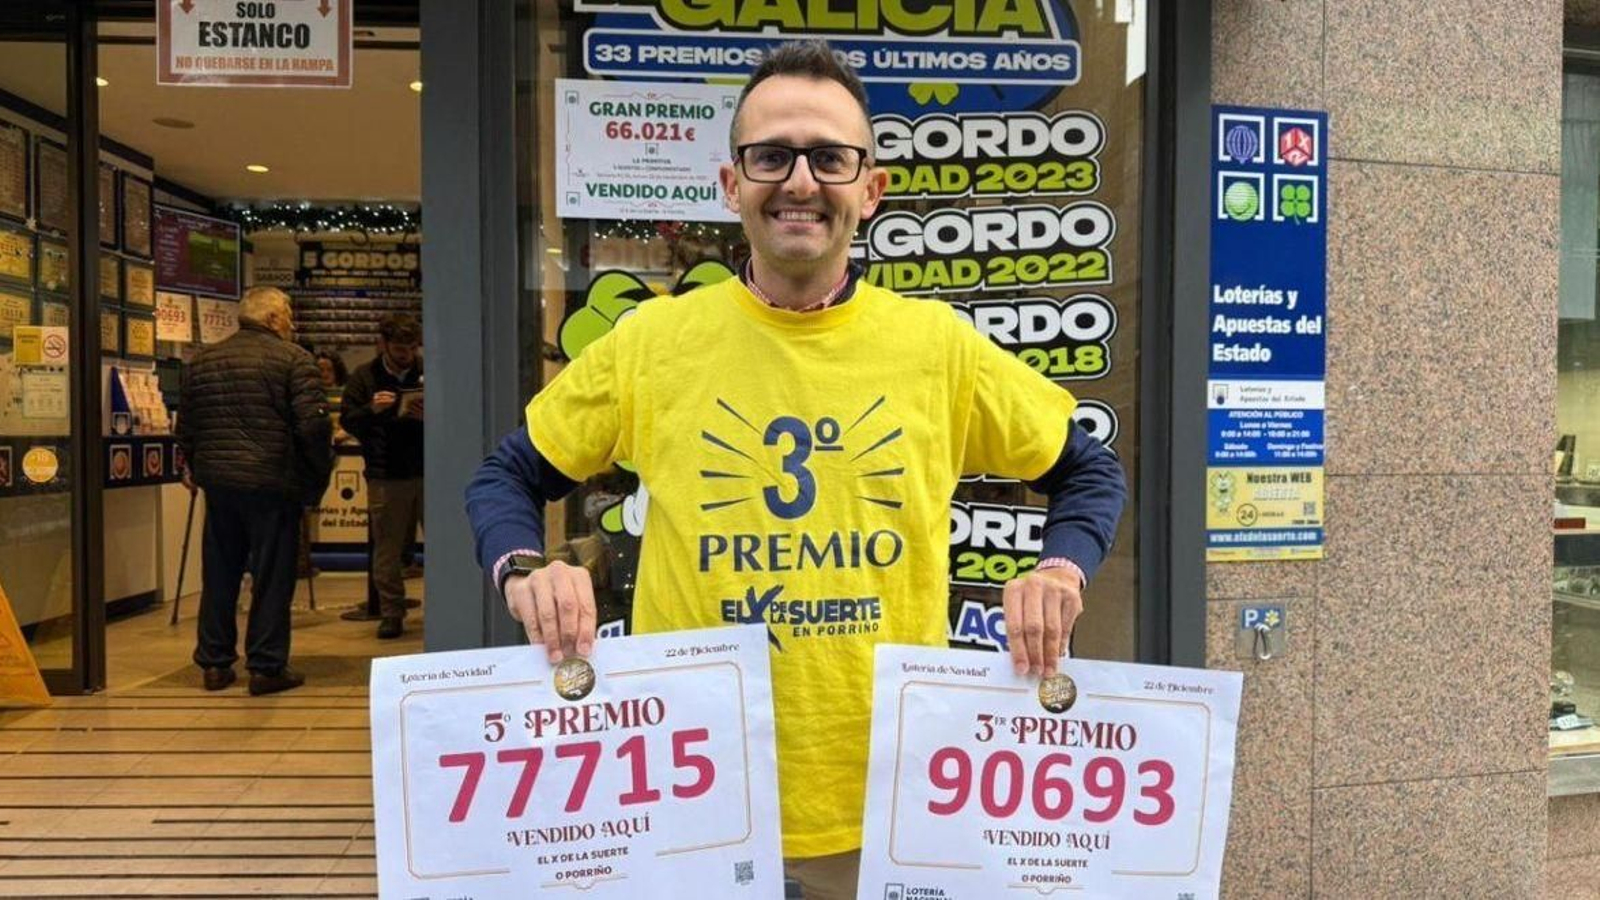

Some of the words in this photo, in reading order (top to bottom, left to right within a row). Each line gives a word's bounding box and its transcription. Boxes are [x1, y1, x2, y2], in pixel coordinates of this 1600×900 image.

[236, 2, 275, 18] SOLO
[199, 21, 310, 49] ESTANCO
[176, 56, 192, 69] NO
[259, 57, 273, 70] EN
[276, 57, 290, 70] LA
[595, 44, 631, 62] 33
[638, 47, 762, 65] PREMIOS
[874, 48, 987, 70] ÚLTIMOS
[994, 50, 1070, 71] AÑOS
[589, 101, 641, 117] GRAN
[645, 103, 715, 120] PREMIO
[874, 116, 1100, 160] GORDO
[976, 161, 1095, 191] 2023
[586, 183, 667, 199] VENDIDO
[672, 182, 717, 203] AQUÍ
[873, 208, 1111, 257] GORDO
[987, 252, 1106, 285] 2022
[1213, 284, 1283, 305] Loterías
[1287, 290, 1298, 310] y
[1213, 314, 1291, 337] Apuestas
[1296, 315, 1322, 334] del
[1213, 342, 1272, 362] Estado
[763, 416, 844, 520] 3º
[1240, 510, 1254, 520] 24
[700, 530, 903, 572] PREMIO
[721, 599, 751, 623] EL
[770, 613, 787, 624] LA
[771, 601, 787, 613] DE
[788, 597, 882, 625] SUERTE
[1245, 610, 1258, 627] P
[793, 627, 811, 637] EN
[817, 622, 879, 637] PORRIÑO
[665, 648, 677, 657] 22
[678, 647, 689, 656] de
[690, 642, 740, 657] Diciembre
[1144, 680, 1153, 690] 22
[1155, 682, 1166, 691] de
[1168, 684, 1215, 695] Diciembre
[524, 696, 665, 738] PREMIO
[1010, 715, 1136, 751] PREMIO
[439, 727, 716, 823] 77715
[927, 746, 1176, 825] 90693
[507, 823, 595, 846] VENDIDO
[601, 812, 650, 838] AQUÍ
[983, 829, 1061, 848] VENDIDO
[1066, 831, 1110, 853] AQUÍ
[538, 855, 549, 865] EL
[551, 854, 558, 863] X
[560, 853, 574, 863] DE
[576, 851, 588, 861] LA
[591, 846, 629, 859] SUERTE
[1007, 857, 1018, 866] EL
[1020, 858, 1027, 866] X
[1028, 858, 1040, 867] DE
[1041, 858, 1052, 867] LA
[1054, 858, 1088, 868] SUERTE
[556, 871, 563, 880] O
[566, 864, 612, 879] PORRIÑO
[1022, 874, 1028, 883] O
[1030, 873, 1071, 884] PORRIÑO
[906, 886, 945, 897] LOTERÍA
